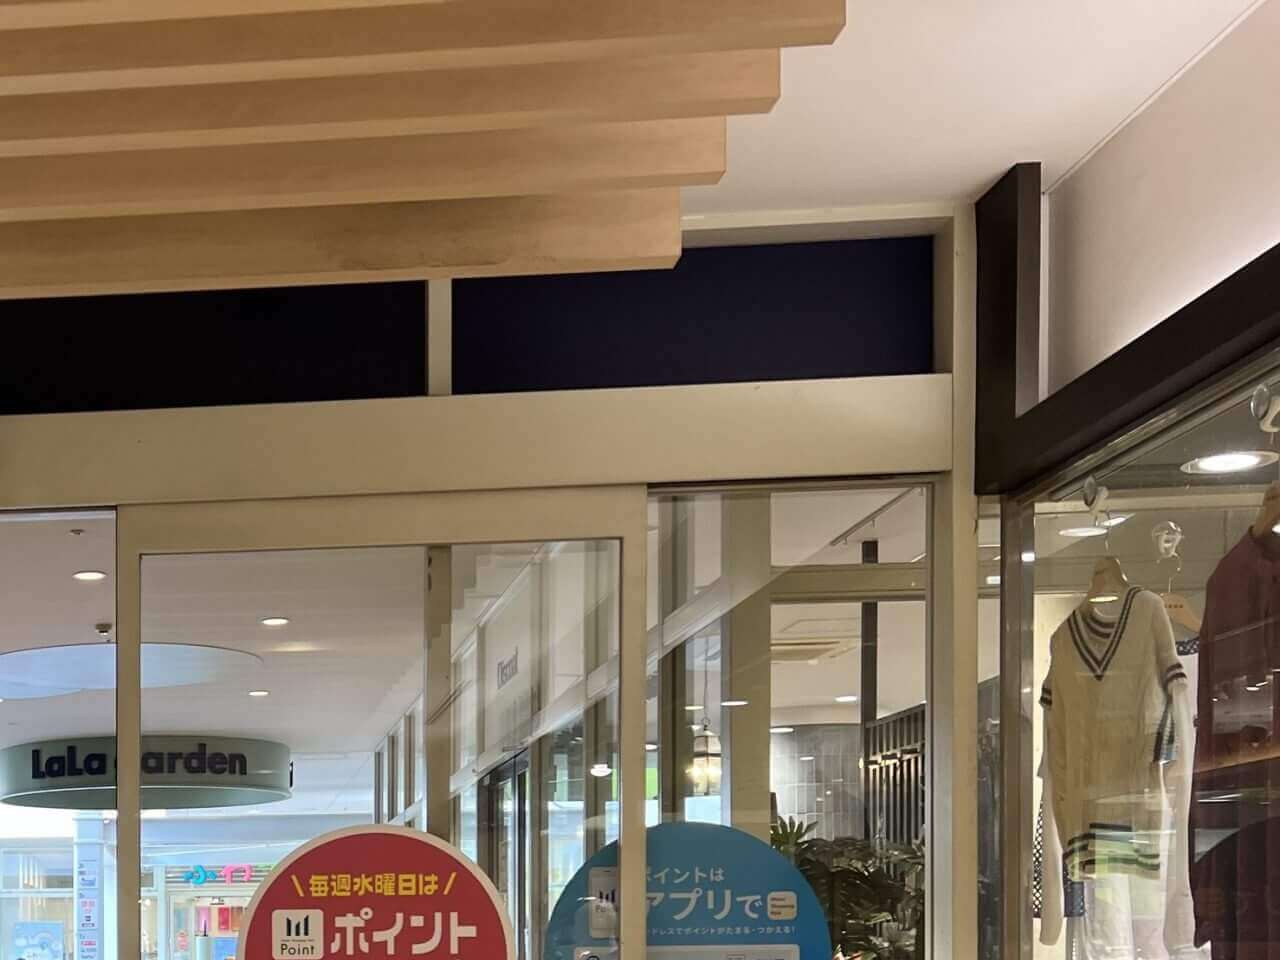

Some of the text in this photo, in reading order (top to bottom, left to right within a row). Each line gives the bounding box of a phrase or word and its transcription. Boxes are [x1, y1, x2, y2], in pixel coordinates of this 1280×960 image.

[31, 743, 247, 779] LaLa arden
[309, 873, 438, 897] 毎週水曜日は
[646, 867, 725, 884] イントは
[330, 907, 477, 955] ポイント
[280, 943, 315, 956] Point
